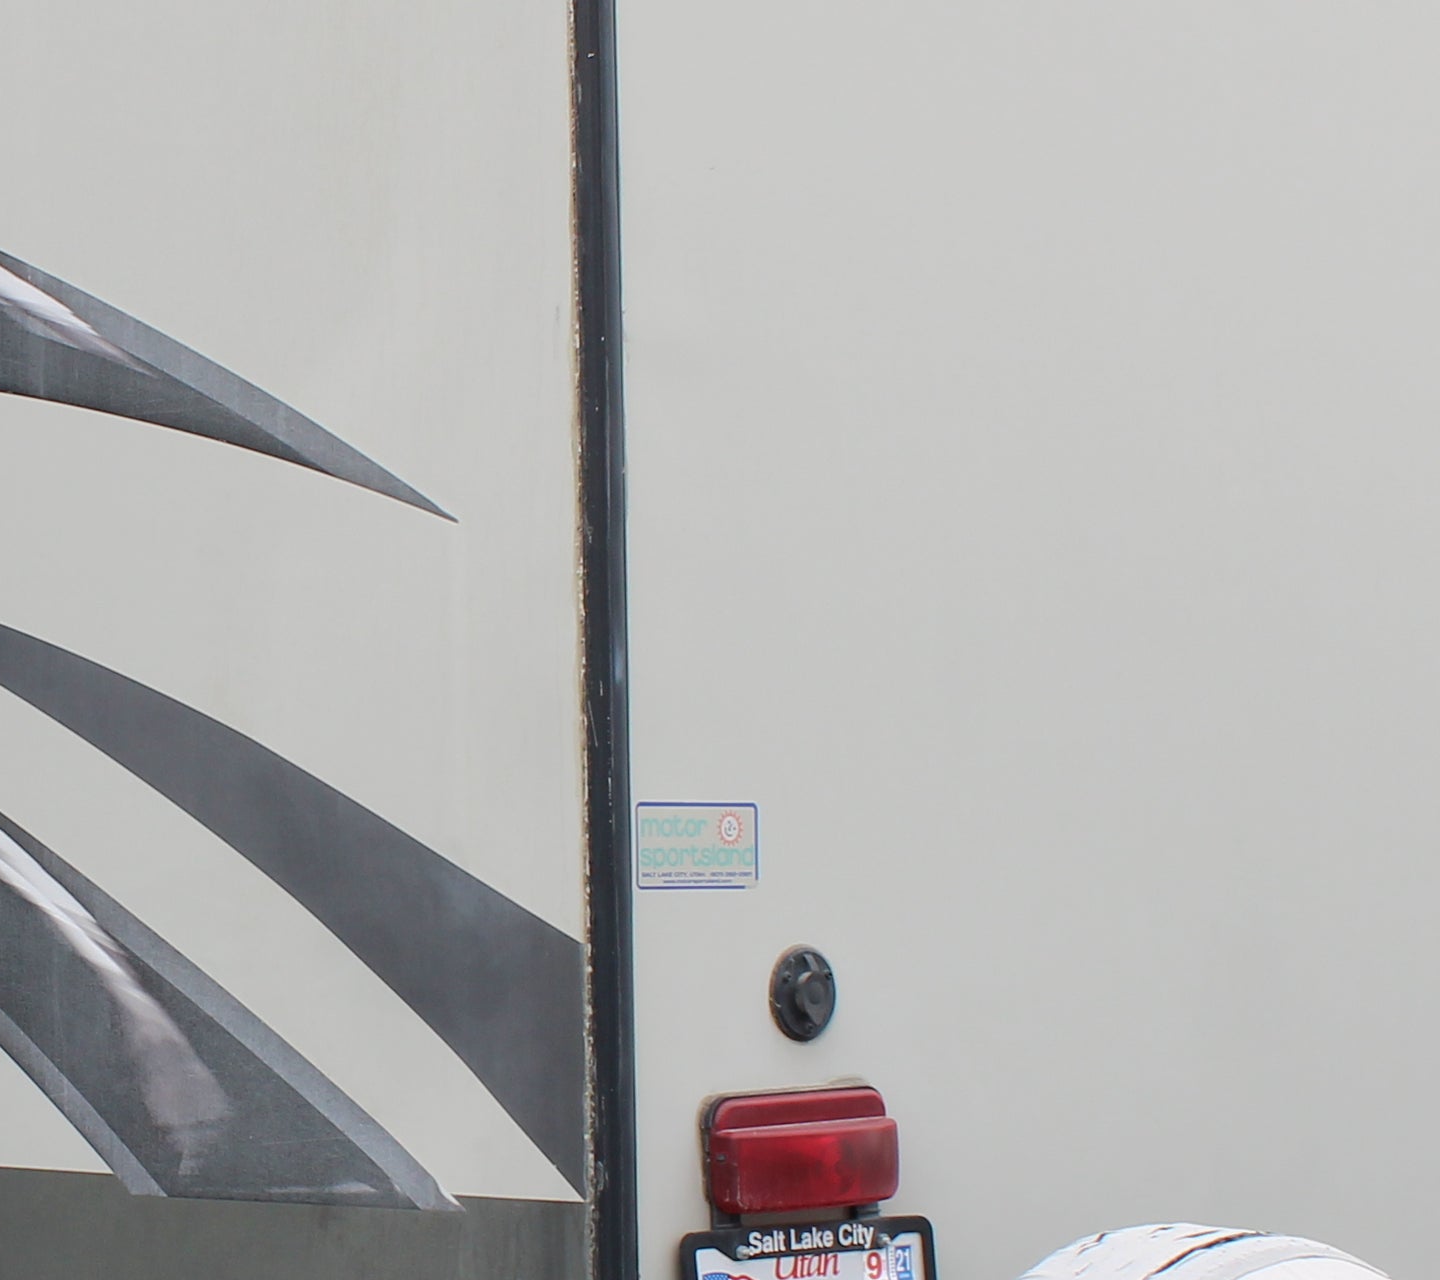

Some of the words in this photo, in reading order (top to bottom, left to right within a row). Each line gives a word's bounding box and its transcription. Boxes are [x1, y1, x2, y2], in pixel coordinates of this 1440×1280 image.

[640, 815, 708, 838] motor
[640, 844, 755, 869] sportsland
[747, 1229, 785, 1254] Salt
[790, 1226, 833, 1251] Lake
[838, 1223, 875, 1249] City
[774, 1253, 839, 1280] Utah
[866, 1251, 882, 1279] 9
[895, 1246, 911, 1271] 21
